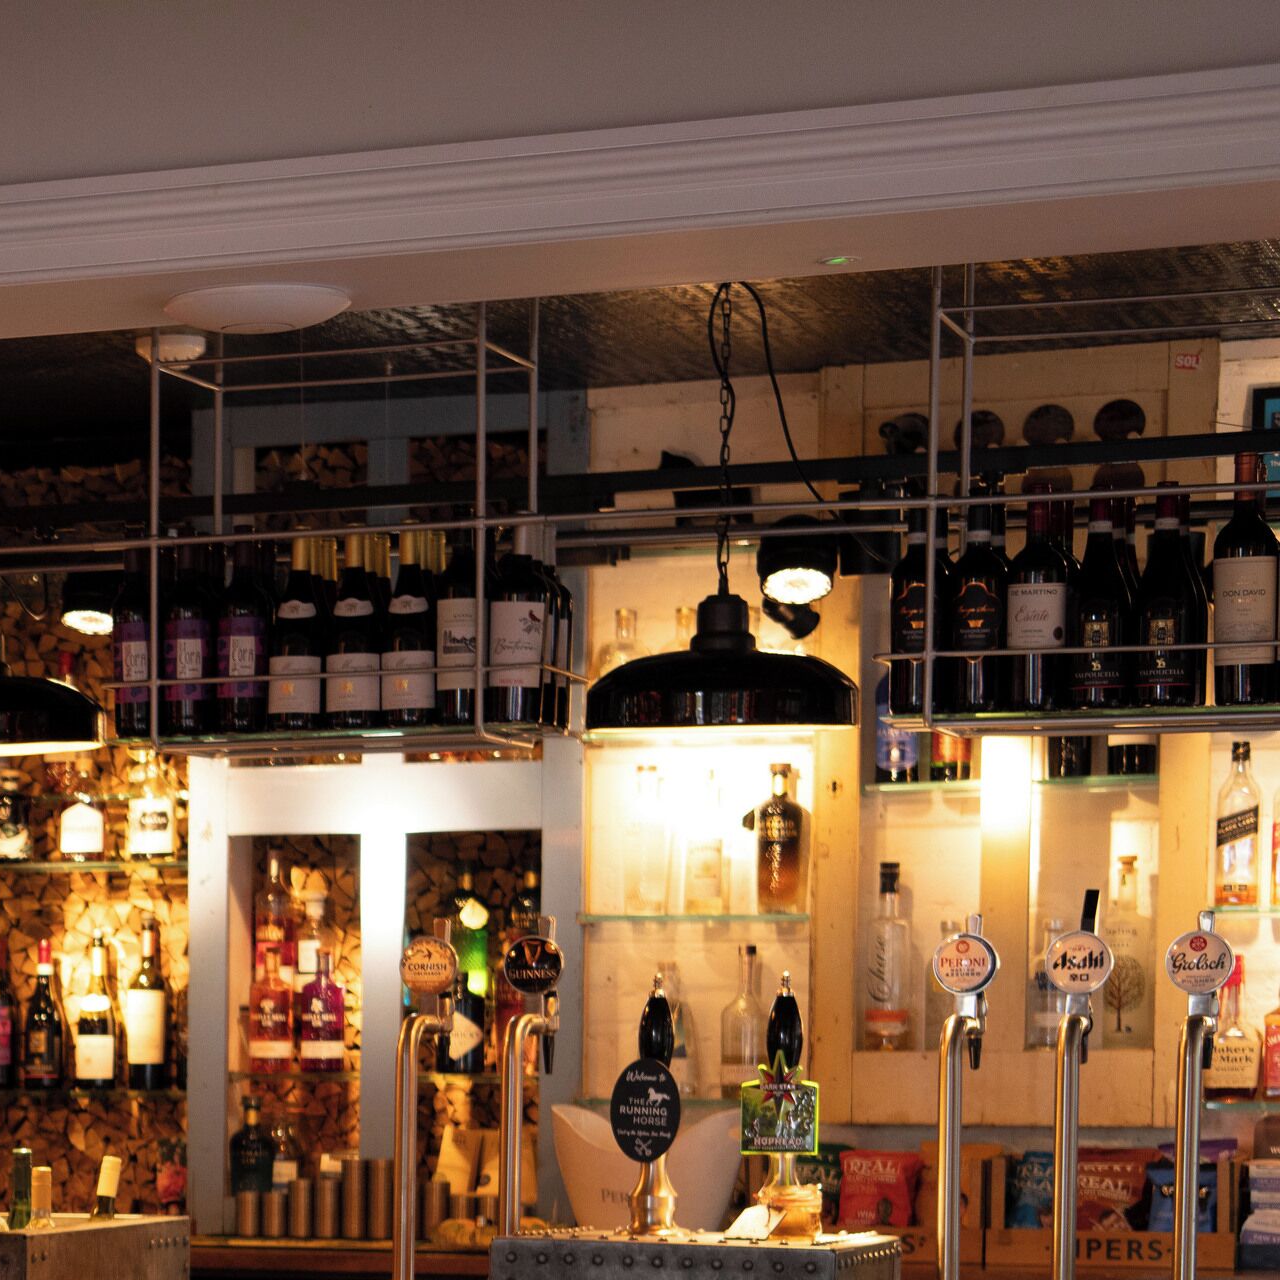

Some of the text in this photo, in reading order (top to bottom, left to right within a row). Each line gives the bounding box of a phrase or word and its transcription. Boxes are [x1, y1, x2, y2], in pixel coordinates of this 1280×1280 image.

[1222, 588, 1266, 598] DON DAVID
[940, 957, 986, 968] PERONI
[1052, 950, 1105, 970] Asahi
[1171, 952, 1226, 975] Grolsch
[408, 963, 447, 971] CORNISH
[508, 968, 559, 980] GUINNESS
[1219, 1054, 1254, 1064] Mark
[629, 1097, 645, 1106] THE
[620, 1105, 668, 1116] RUNNING
[633, 1116, 667, 1126] HORSE
[753, 1136, 802, 1147] HOPHEAD
[849, 1158, 897, 1177] REAL
